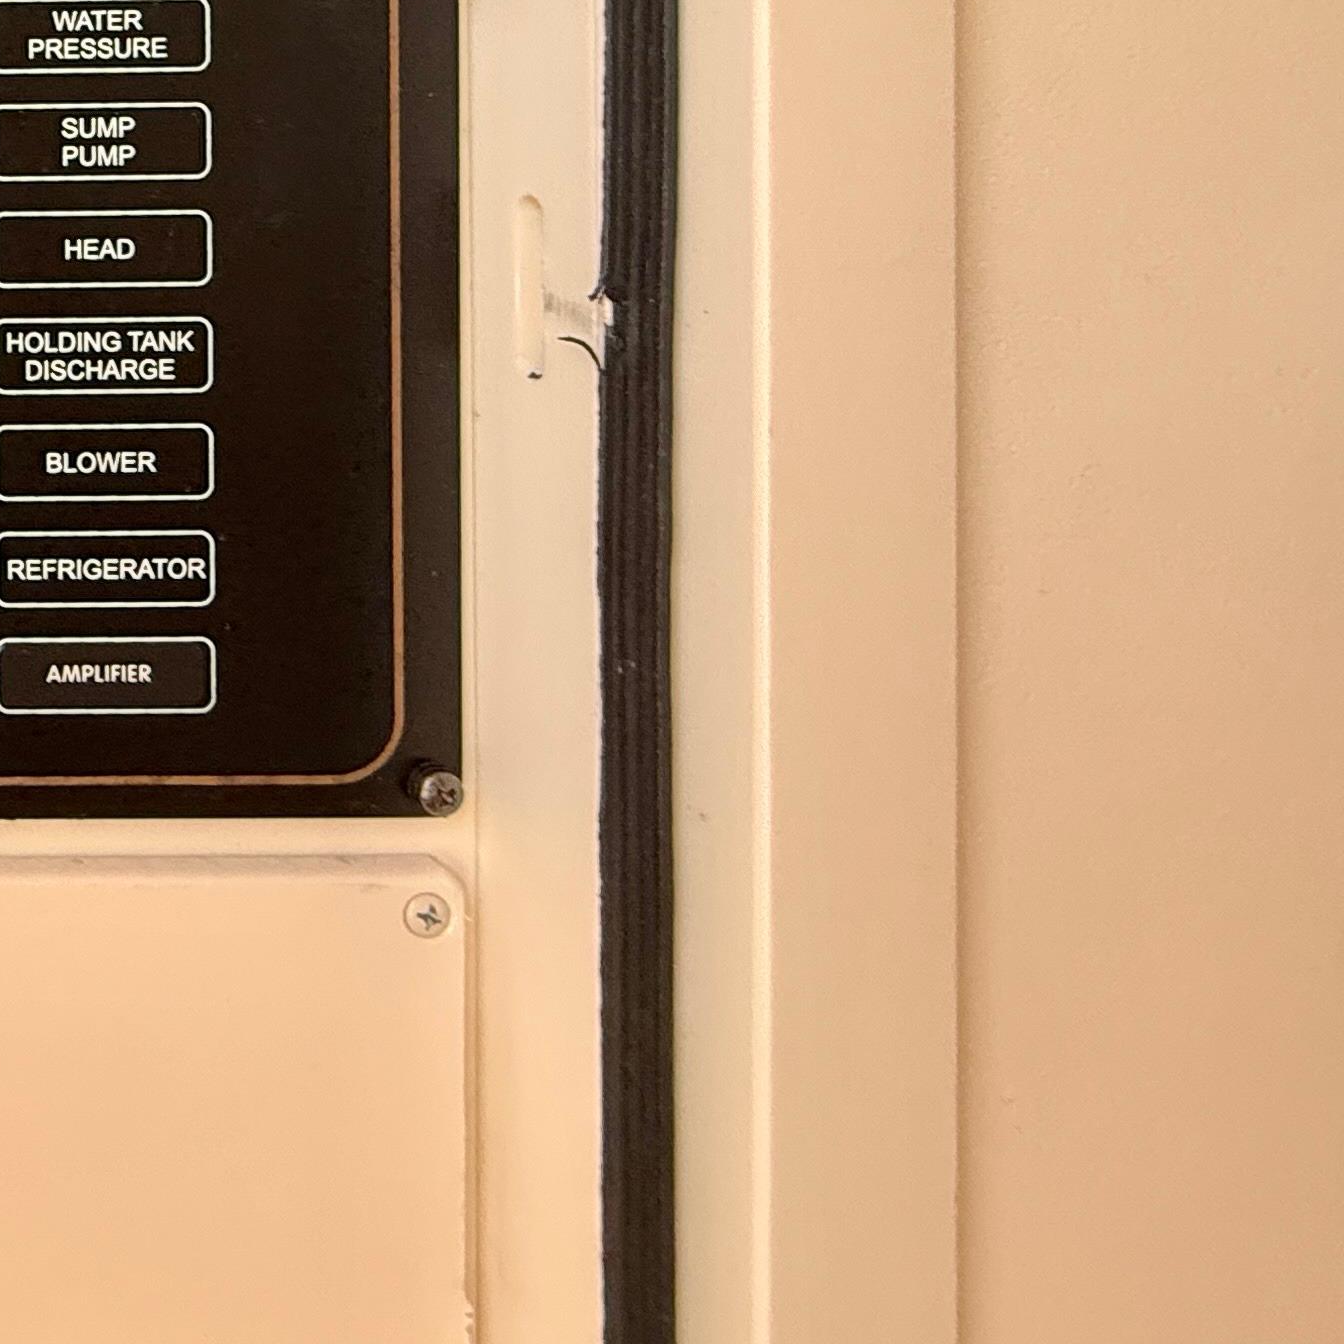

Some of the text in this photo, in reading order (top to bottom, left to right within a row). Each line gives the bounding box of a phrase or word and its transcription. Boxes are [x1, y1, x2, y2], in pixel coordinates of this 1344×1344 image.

[51, 9, 144, 32] WATER
[28, 36, 169, 60] PRESSURE
[60, 116, 136, 140] SUMP
[61, 144, 137, 167] PUMP
[64, 238, 136, 261] HEAD
[6, 329, 195, 354] HOLDING TANK
[25, 358, 176, 382] DISCHARGE
[45, 451, 158, 474] BLOWER
[7, 557, 207, 581] REFRIGERATOR
[45, 663, 152, 684] AMPLIFIER
